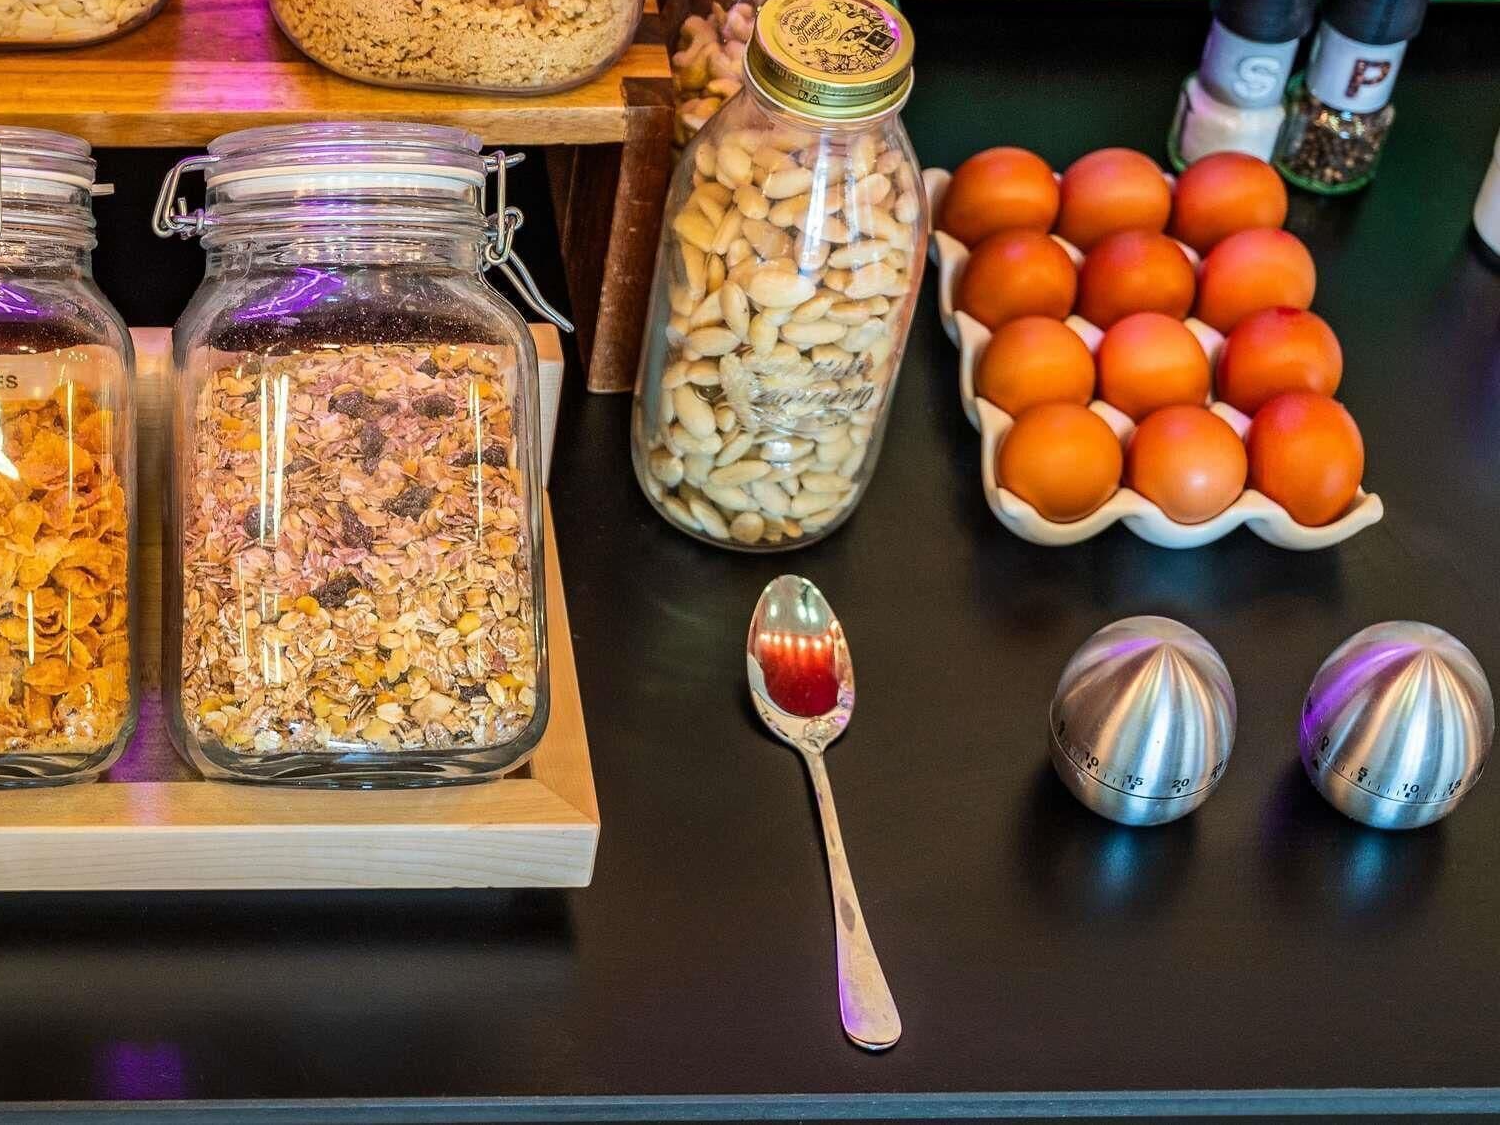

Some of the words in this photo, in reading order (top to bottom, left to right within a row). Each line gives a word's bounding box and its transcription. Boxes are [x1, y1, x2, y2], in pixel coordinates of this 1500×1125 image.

[1233, 55, 1281, 99] S
[1345, 58, 1392, 98] P
[1126, 774, 1145, 787] 15
[1171, 778, 1190, 789] 20
[1401, 782, 1420, 794] 10
